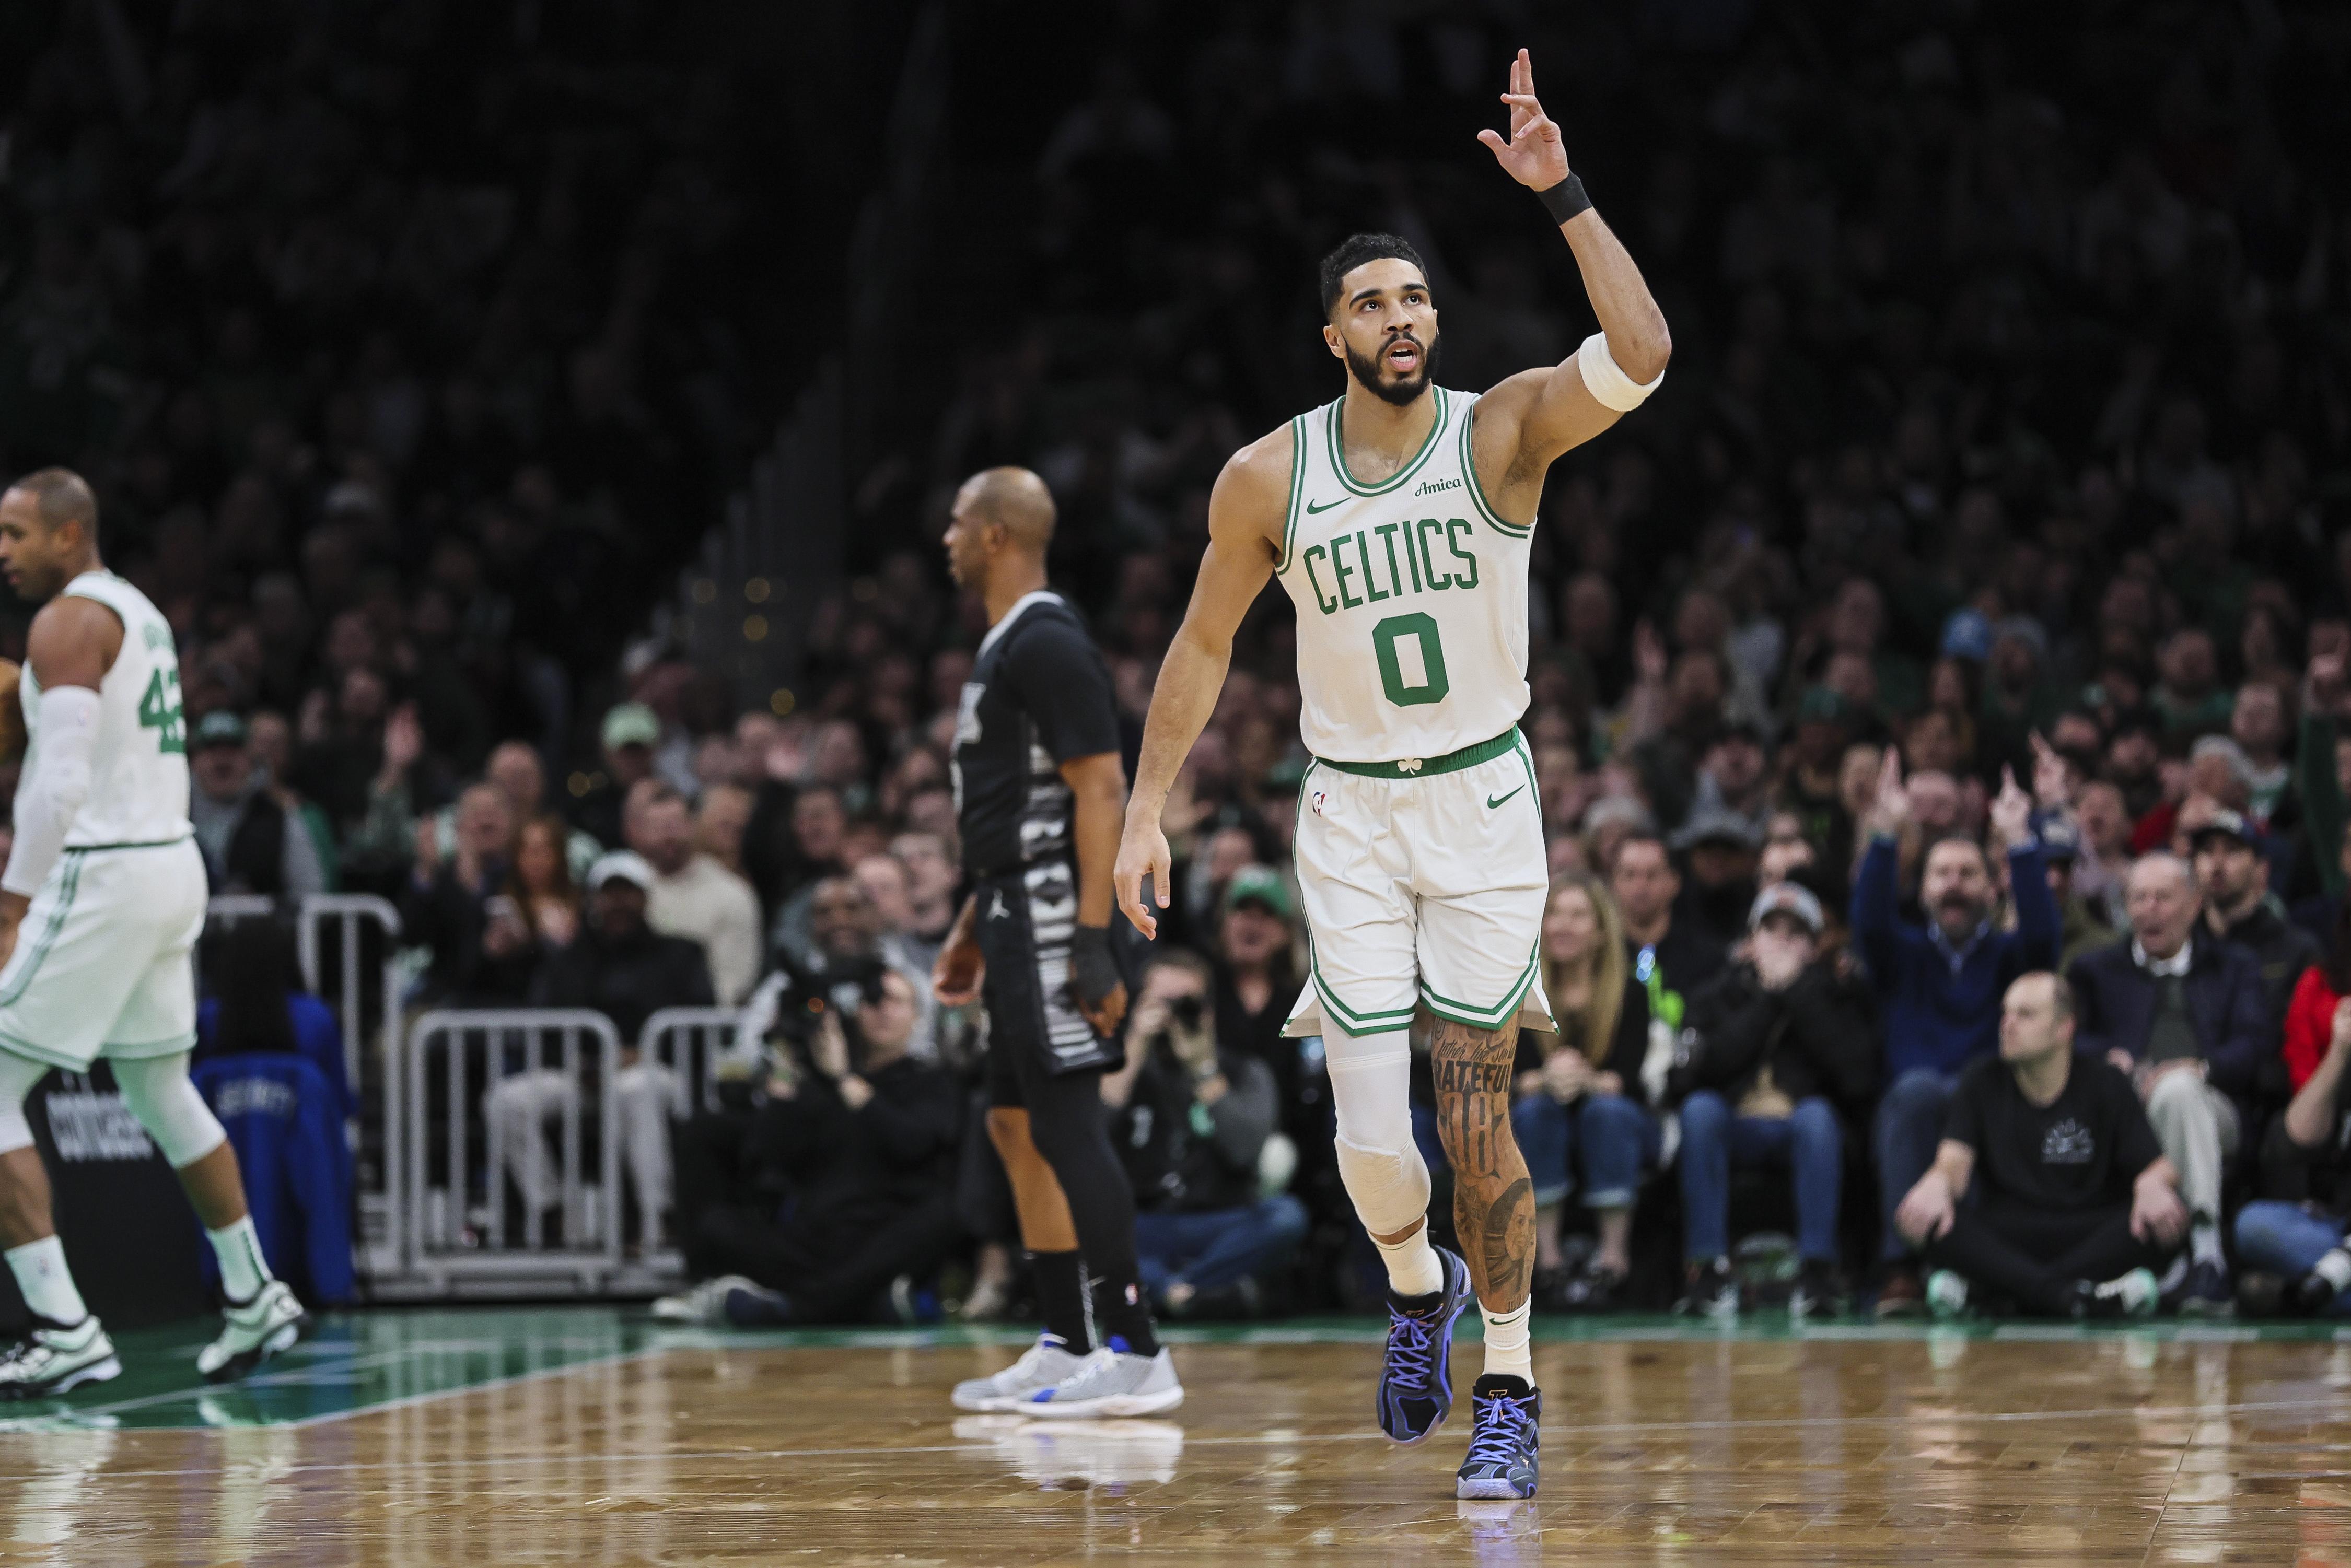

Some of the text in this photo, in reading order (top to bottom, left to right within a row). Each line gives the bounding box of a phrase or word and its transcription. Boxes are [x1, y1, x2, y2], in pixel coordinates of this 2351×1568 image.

[1415, 478, 1462, 497] Amica
[1303, 518, 1478, 615] CELTICS
[1372, 612, 1449, 707] 0
